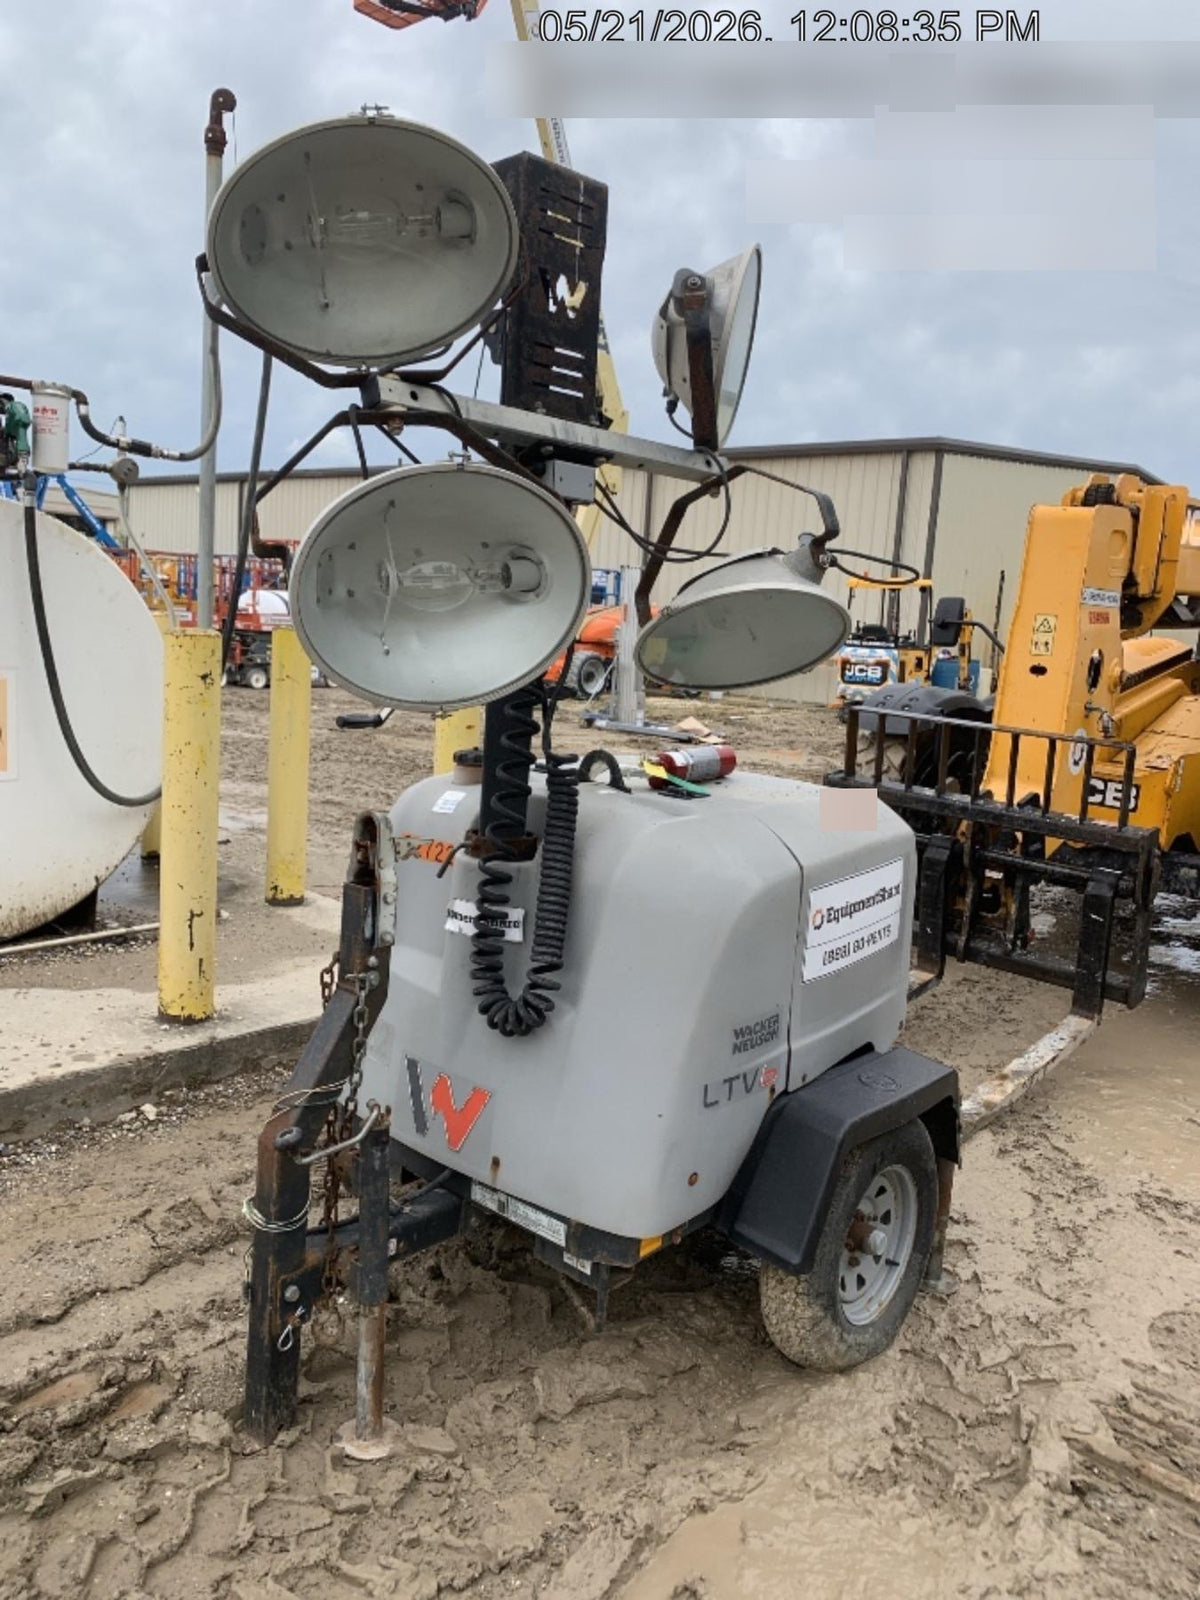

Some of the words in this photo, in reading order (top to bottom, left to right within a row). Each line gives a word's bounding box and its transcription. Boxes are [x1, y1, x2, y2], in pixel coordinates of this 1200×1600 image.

[844, 664, 882, 678] JCB
[1087, 778, 1137, 810] CB
[732, 1025, 779, 1055] NEUSON
[733, 1013, 779, 1040] WACKER
